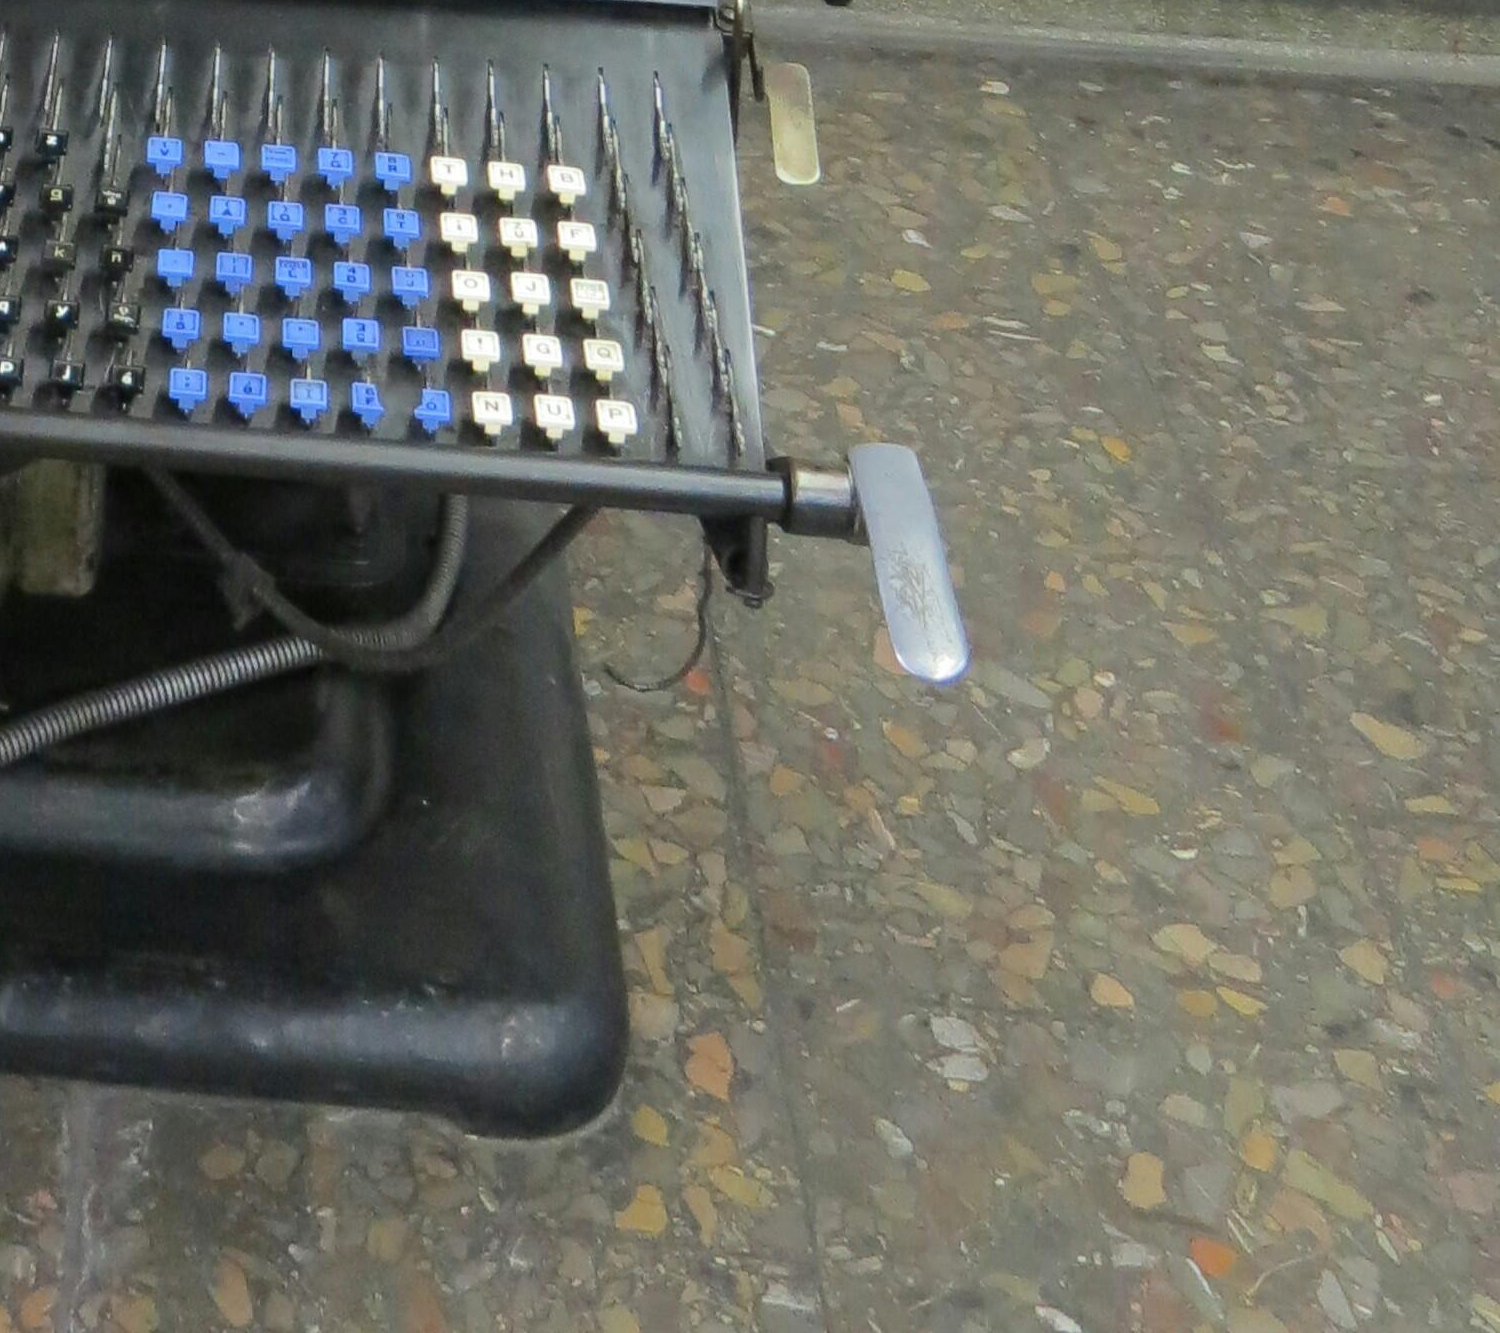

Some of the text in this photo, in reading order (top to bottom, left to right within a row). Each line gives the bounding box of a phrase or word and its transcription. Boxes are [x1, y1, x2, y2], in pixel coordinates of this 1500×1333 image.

[500, 169, 514, 178] H
[50, 188, 63, 201] g
[54, 245, 65, 258] k
[526, 281, 537, 292] J
[484, 400, 499, 412] N
[547, 403, 561, 415] U
[608, 408, 623, 419] P
